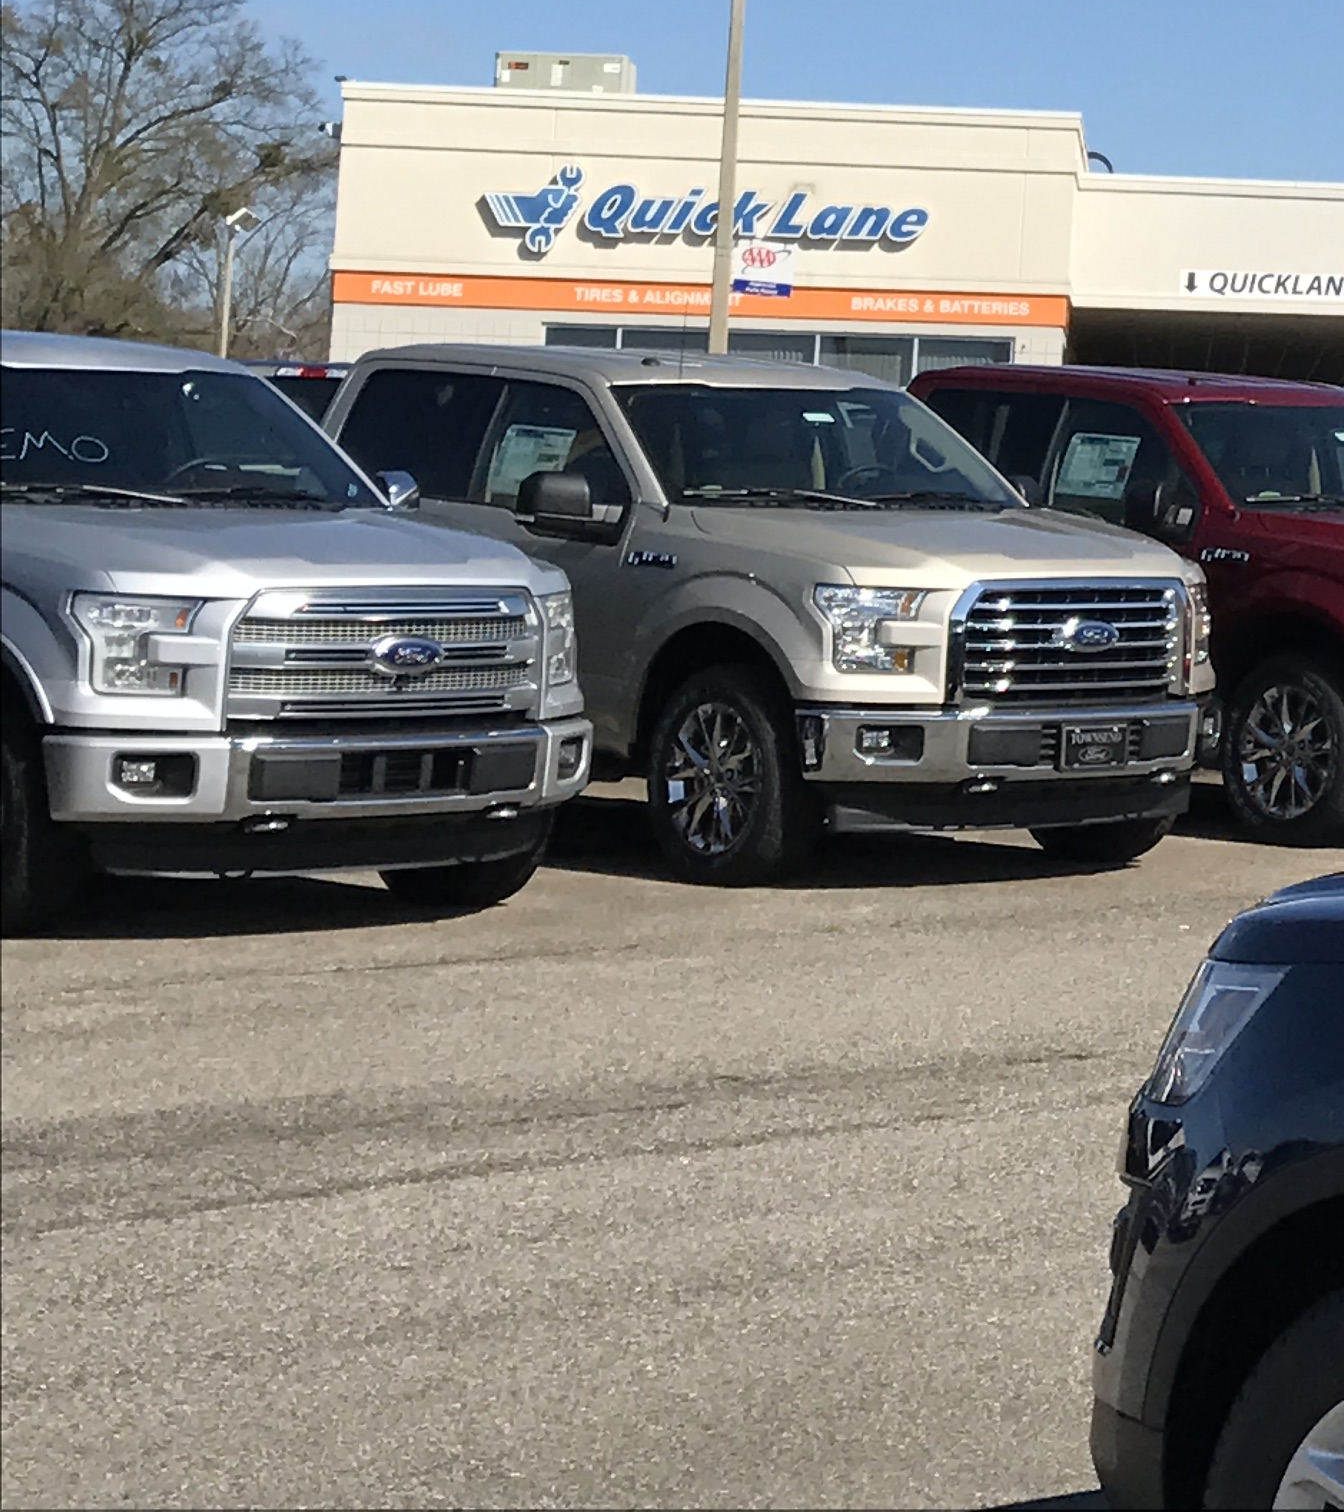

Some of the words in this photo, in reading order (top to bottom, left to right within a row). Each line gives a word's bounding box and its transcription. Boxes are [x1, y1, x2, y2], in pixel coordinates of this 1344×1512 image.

[584, 184, 772, 238] Quick
[767, 190, 930, 242] Lane
[371, 279, 415, 295] FAST
[418, 281, 464, 297] LUBE
[574, 287, 624, 303] TIRES
[627, 289, 639, 304] &
[643, 289, 741, 307] ALIGNMT
[851, 296, 919, 313] BRAKES
[922, 298, 935, 314] &
[939, 299, 1030, 317] BATTERIES
